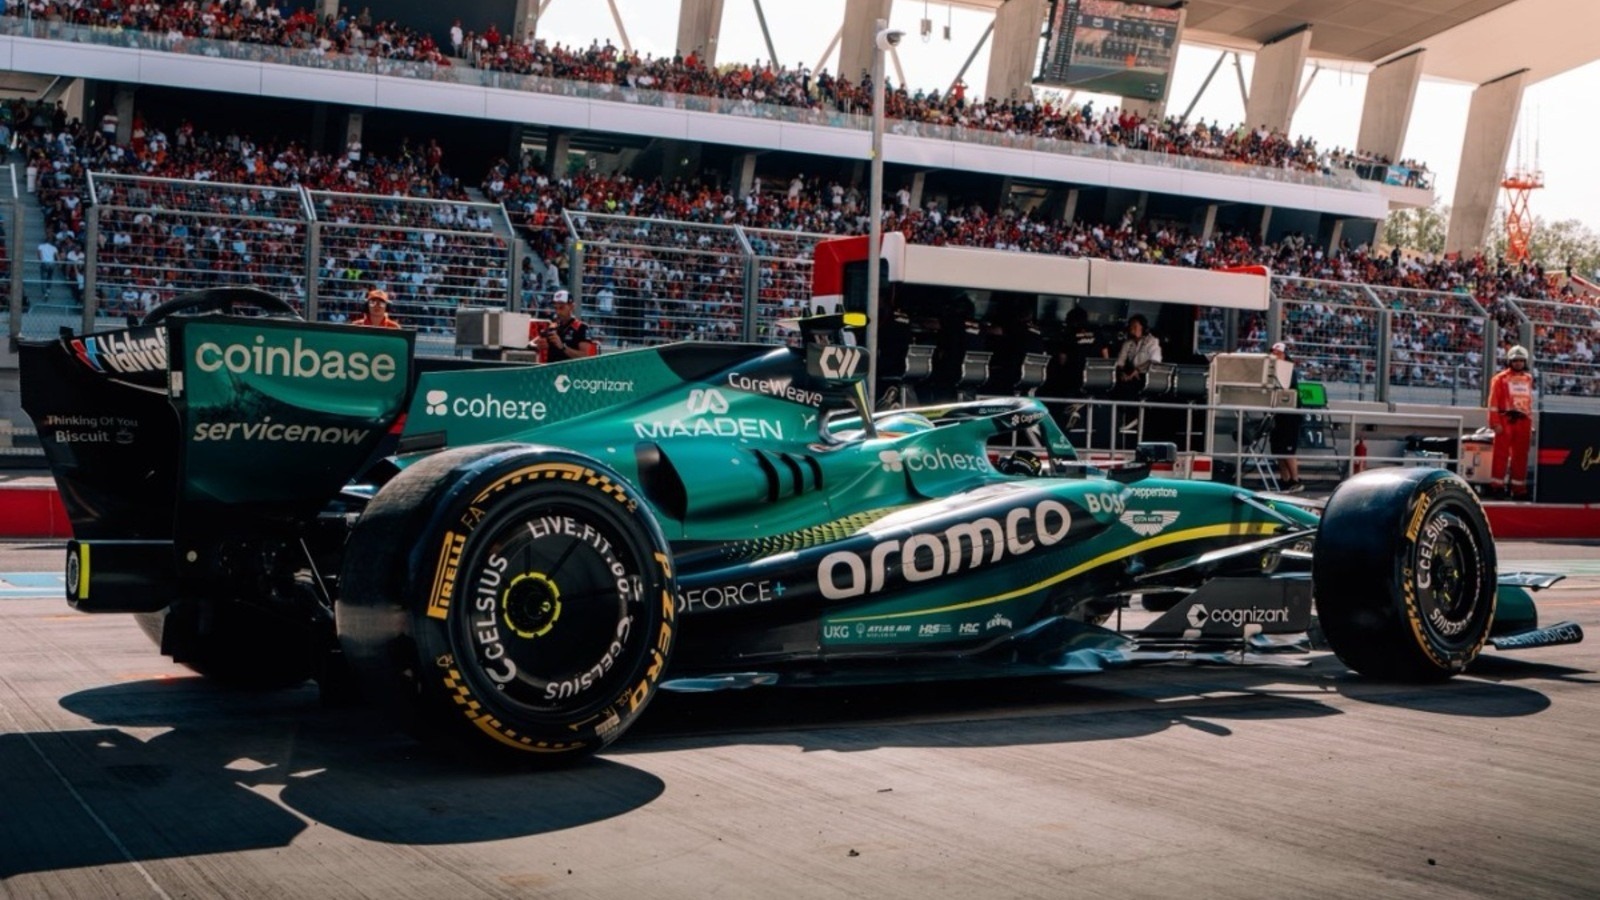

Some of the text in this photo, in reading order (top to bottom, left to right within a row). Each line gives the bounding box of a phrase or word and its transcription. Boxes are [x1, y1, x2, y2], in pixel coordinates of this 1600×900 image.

[195, 335, 396, 382] coinbase
[572, 378, 634, 394] cognizant
[728, 372, 824, 407] CoreWeave
[453, 393, 547, 421] cohere
[46, 415, 138, 428] Thinking Of You
[193, 416, 371, 445] servicenow
[633, 418, 784, 440] MAADEN
[55, 430, 110, 443] Biscuit
[907, 448, 989, 473] cohere
[817, 499, 1072, 600] aramco
[427, 531, 466, 620] PIRELLI
[475, 553, 509, 661] CELSIUS
[1211, 605, 1290, 628] cognizant
[823, 625, 850, 639] UKG
